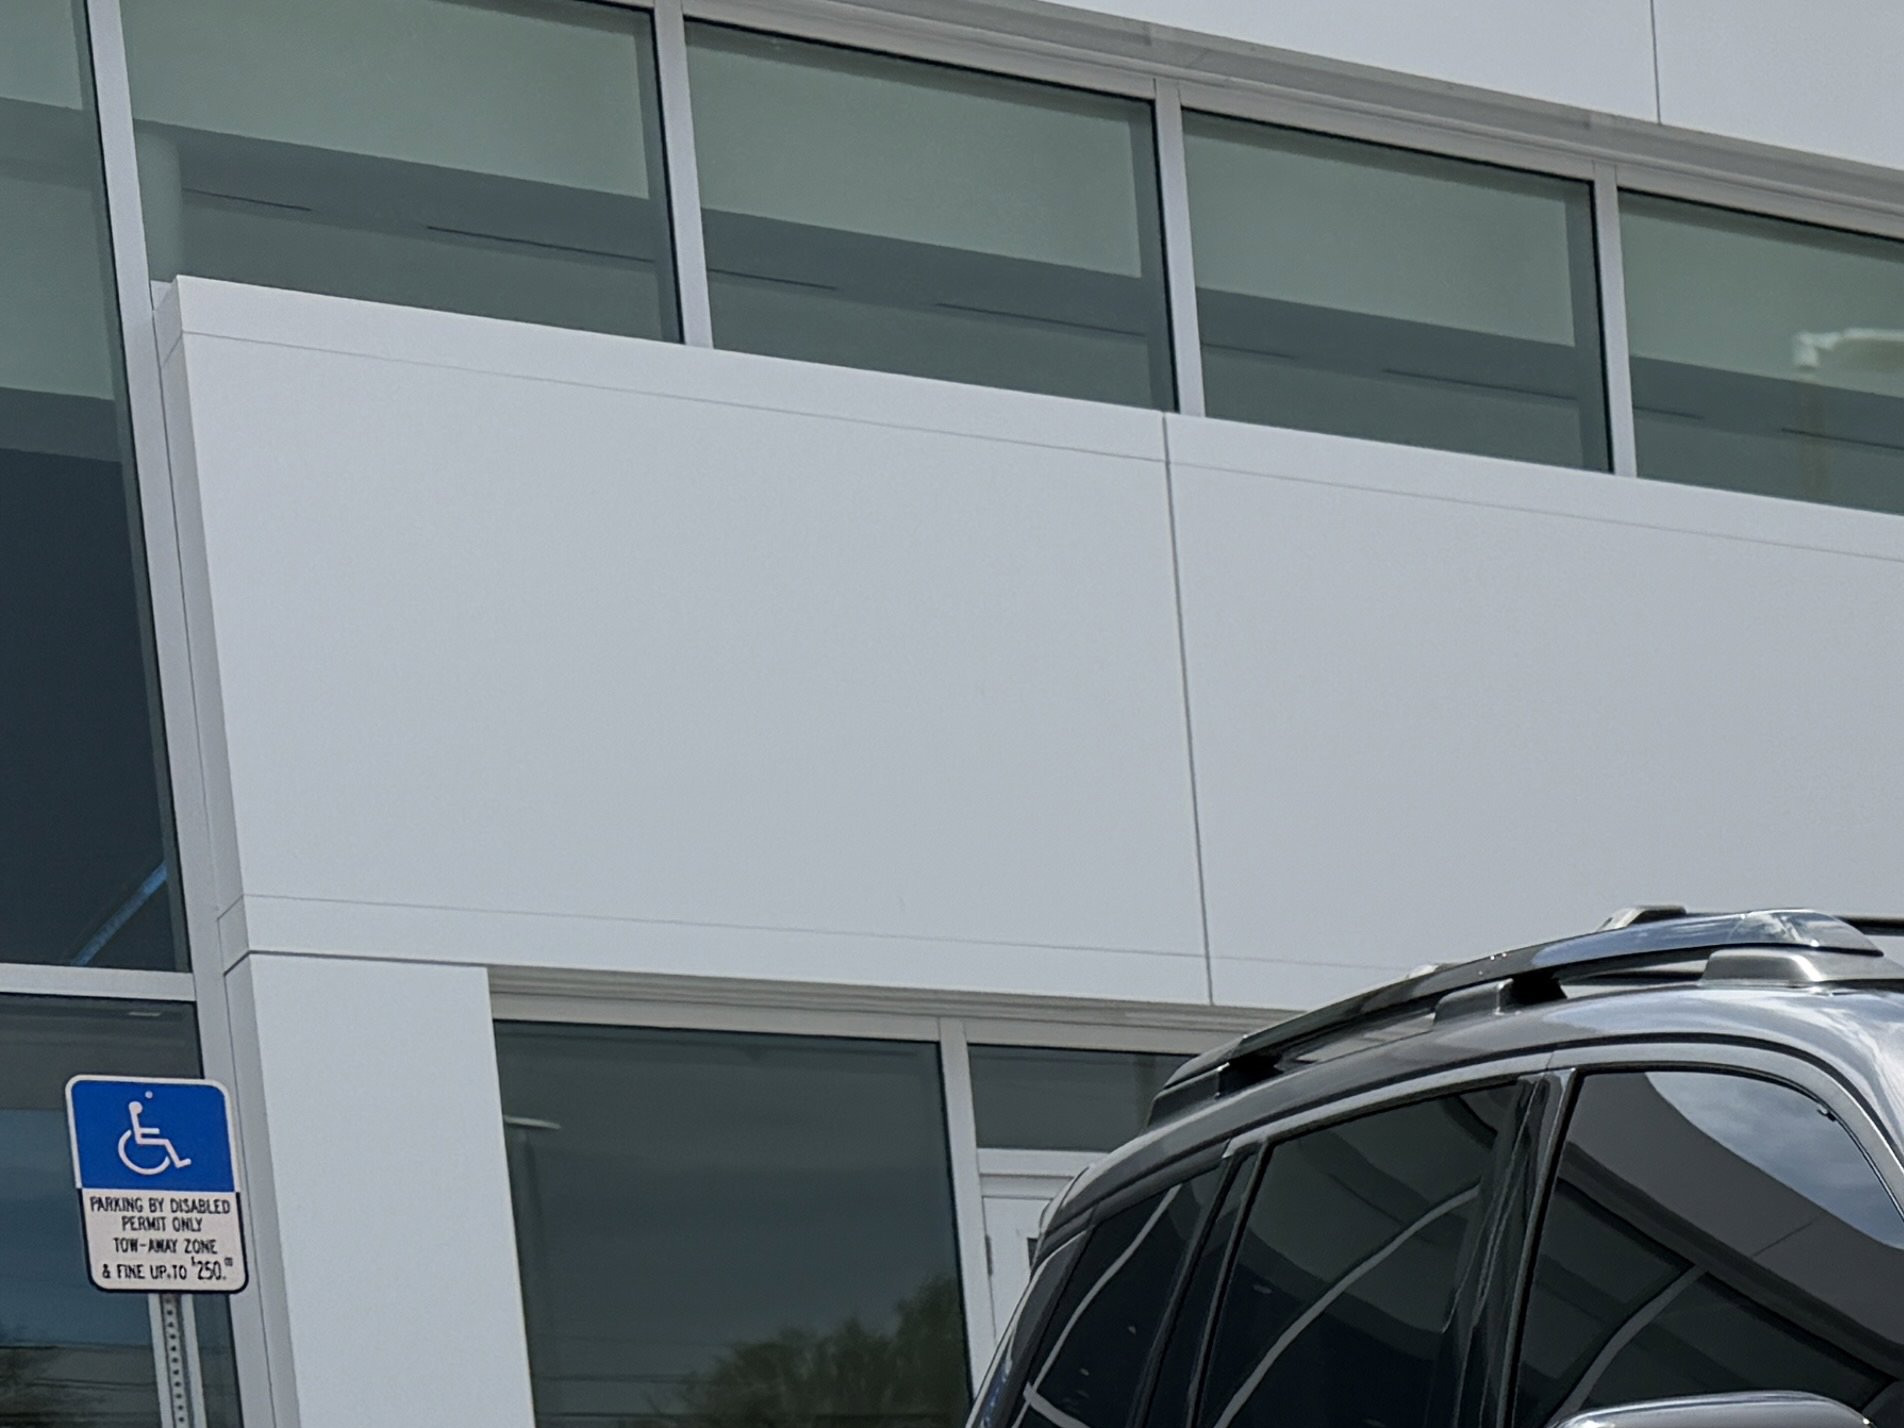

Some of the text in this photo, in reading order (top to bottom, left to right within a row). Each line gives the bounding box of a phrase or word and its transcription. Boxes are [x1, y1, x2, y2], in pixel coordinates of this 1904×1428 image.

[90, 1196, 231, 1215] PARKING BY DISABLED
[121, 1216, 203, 1232] PERMIT ONLY
[113, 1237, 218, 1255] TOW-AWAY ZONE
[102, 1263, 111, 1279] &
[117, 1263, 145, 1279] FINE
[173, 1264, 187, 1280] TO
